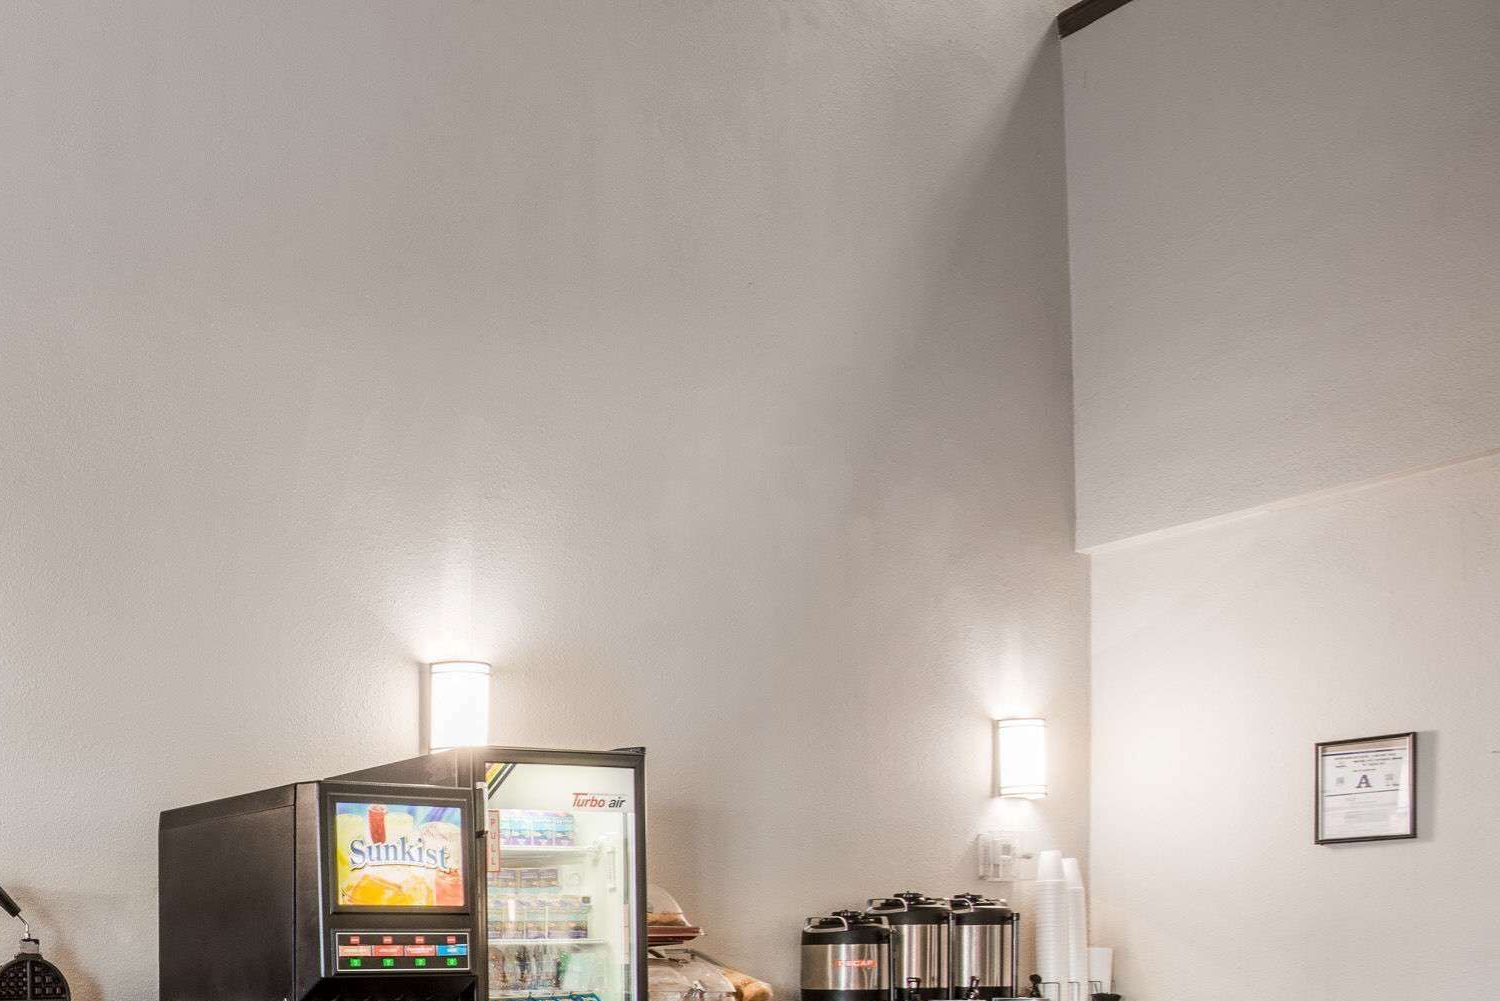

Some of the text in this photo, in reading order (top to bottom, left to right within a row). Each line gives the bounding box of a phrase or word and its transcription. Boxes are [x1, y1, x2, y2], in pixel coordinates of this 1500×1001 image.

[1355, 774, 1372, 789] A
[572, 793, 626, 808] Turbo air
[350, 837, 450, 869] Sunkist
